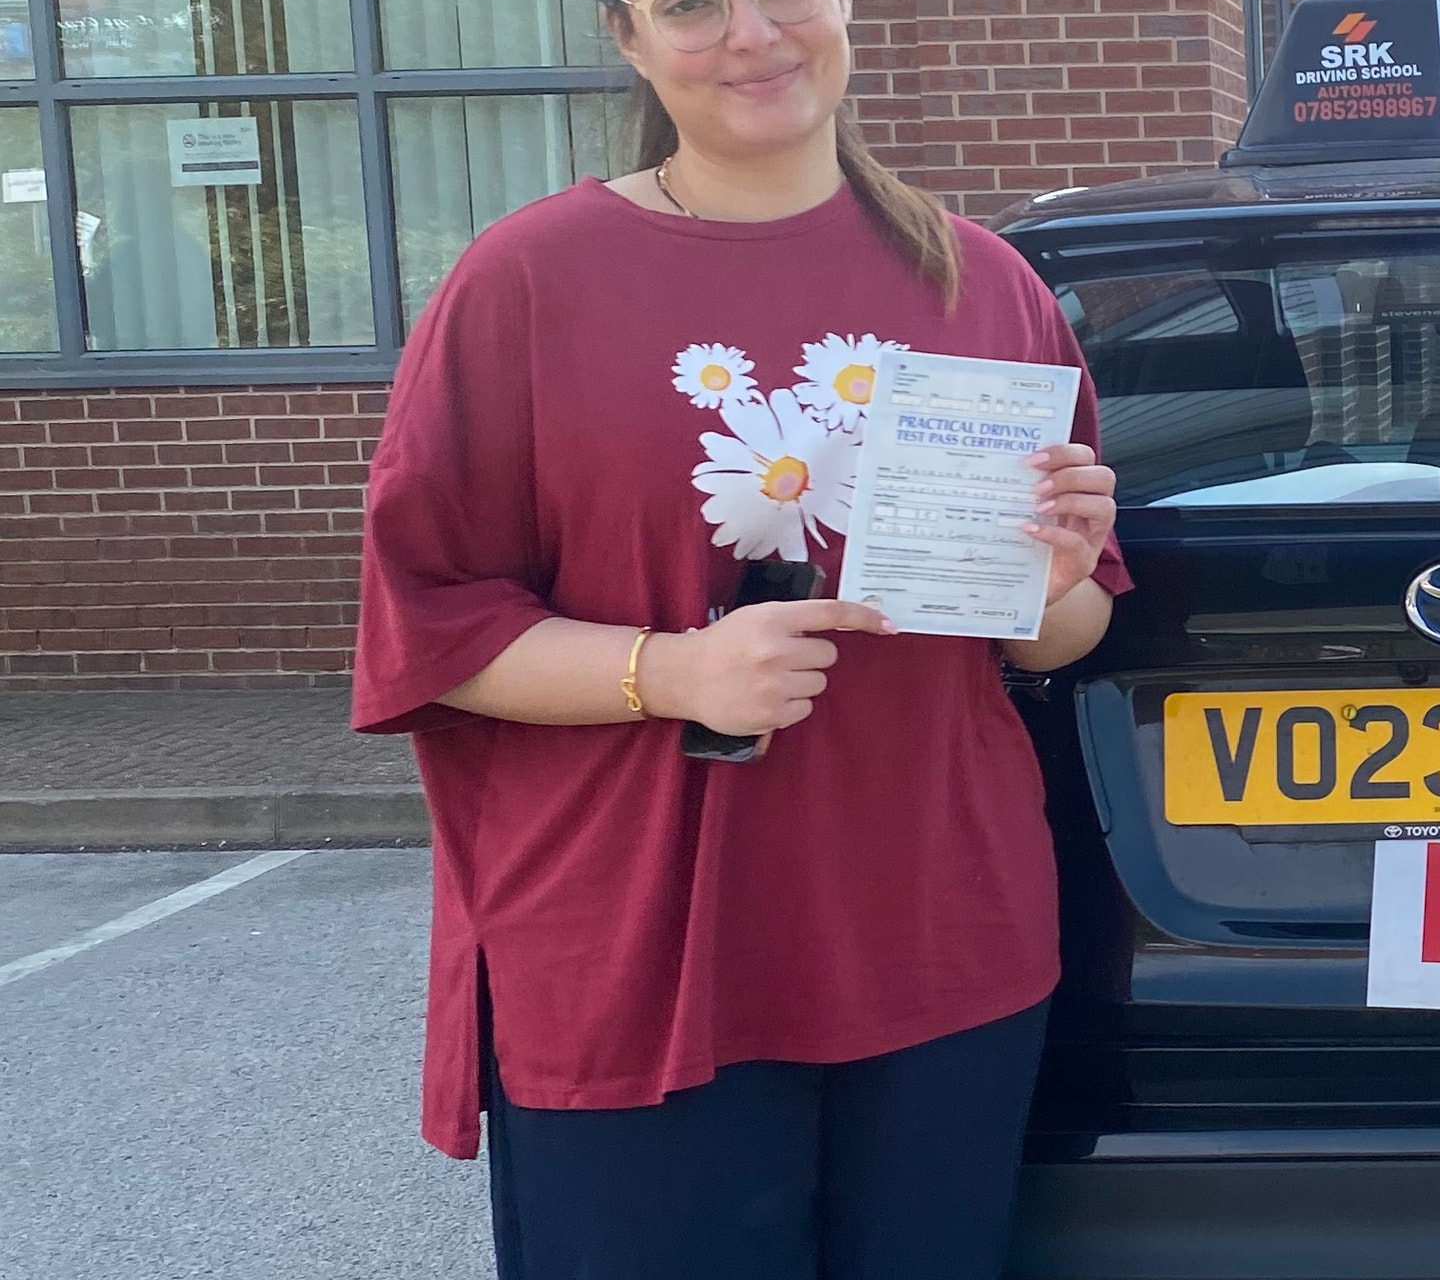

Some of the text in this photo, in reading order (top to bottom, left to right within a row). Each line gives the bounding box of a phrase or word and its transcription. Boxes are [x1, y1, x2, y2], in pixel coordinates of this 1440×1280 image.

[1320, 41, 1395, 69] SRK
[1295, 64, 1422, 85] DRIVING SCHOOL
[1317, 82, 1413, 99] AUTOMATIC
[1293, 96, 1437, 123] 07852998967
[898, 415, 1042, 440] PRACTICAL DRIVING
[897, 429, 1040, 453] TEST PASS CERTIFICATE
